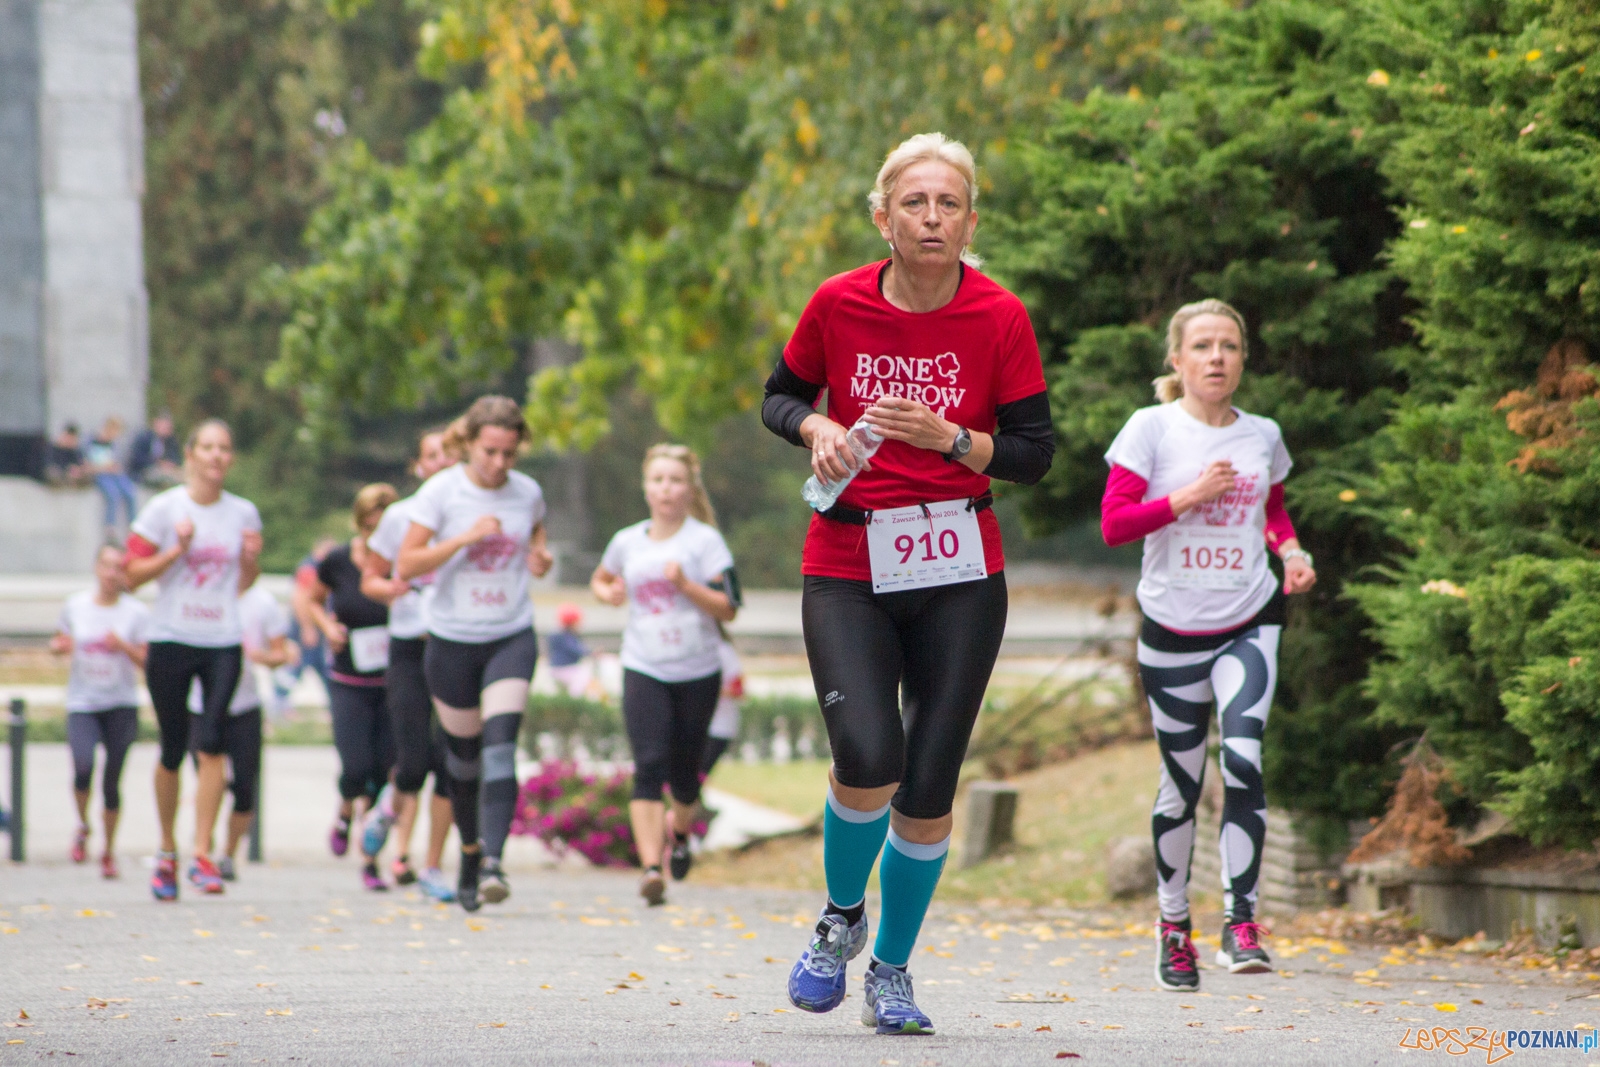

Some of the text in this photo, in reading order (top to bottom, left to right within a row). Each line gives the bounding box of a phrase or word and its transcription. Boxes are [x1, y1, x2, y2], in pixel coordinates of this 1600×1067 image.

[855, 353, 933, 382] BONE
[850, 376, 966, 408] MARROW
[892, 515, 916, 524] Zawsze
[943, 509, 959, 519] 2016
[894, 529, 960, 565] 910
[1180, 546, 1244, 570] 1052
